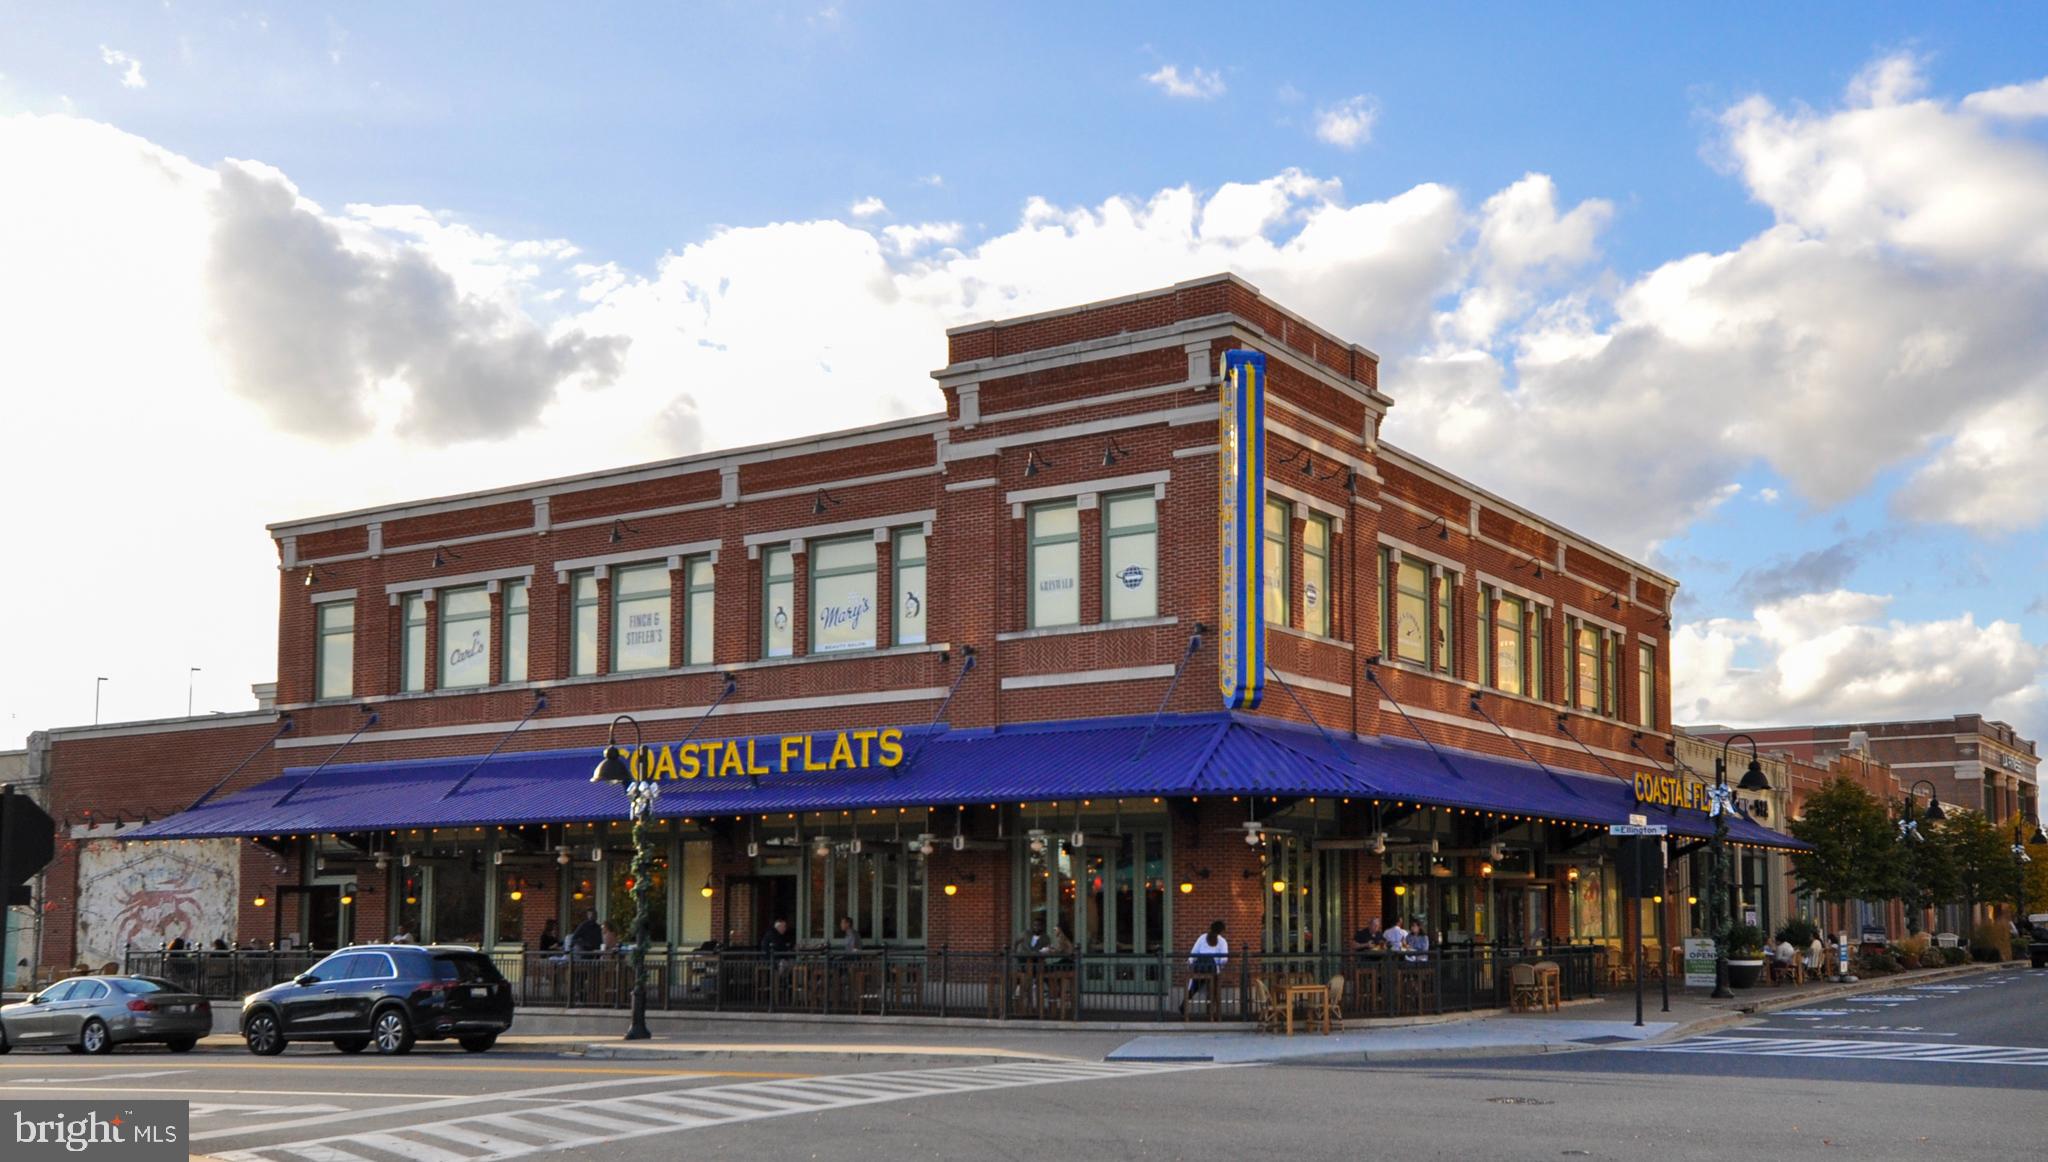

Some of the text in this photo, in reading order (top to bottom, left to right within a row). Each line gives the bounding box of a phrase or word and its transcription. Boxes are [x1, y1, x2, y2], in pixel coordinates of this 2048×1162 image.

[629, 613, 652, 628] FINCH
[820, 597, 870, 631] Mary's
[626, 629, 663, 646] STIFLER'S
[450, 638, 484, 666] Carl's
[780, 728, 904, 773] FLATS
[1634, 772, 1692, 809] COASTAL
[1620, 825, 1657, 834] Ellington
